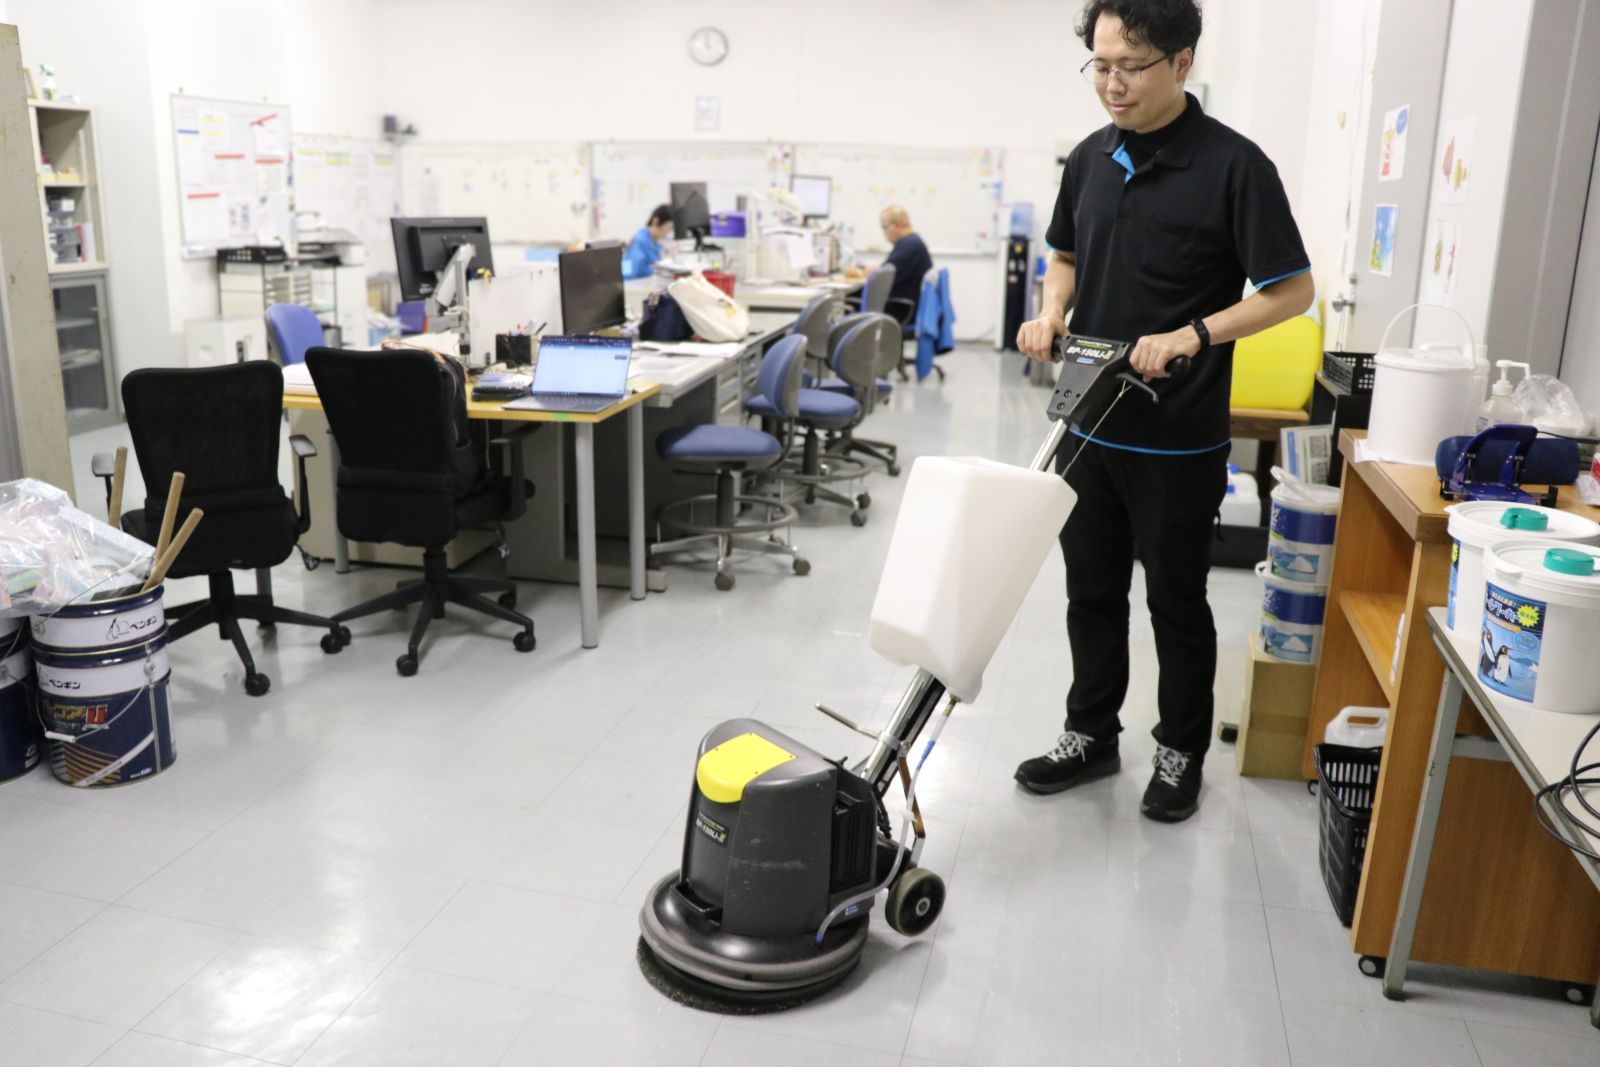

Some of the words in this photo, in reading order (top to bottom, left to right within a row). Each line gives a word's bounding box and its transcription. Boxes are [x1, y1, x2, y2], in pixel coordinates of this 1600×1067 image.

[129, 615, 158, 630] ペンギン
[49, 678, 82, 690] ペンギン
